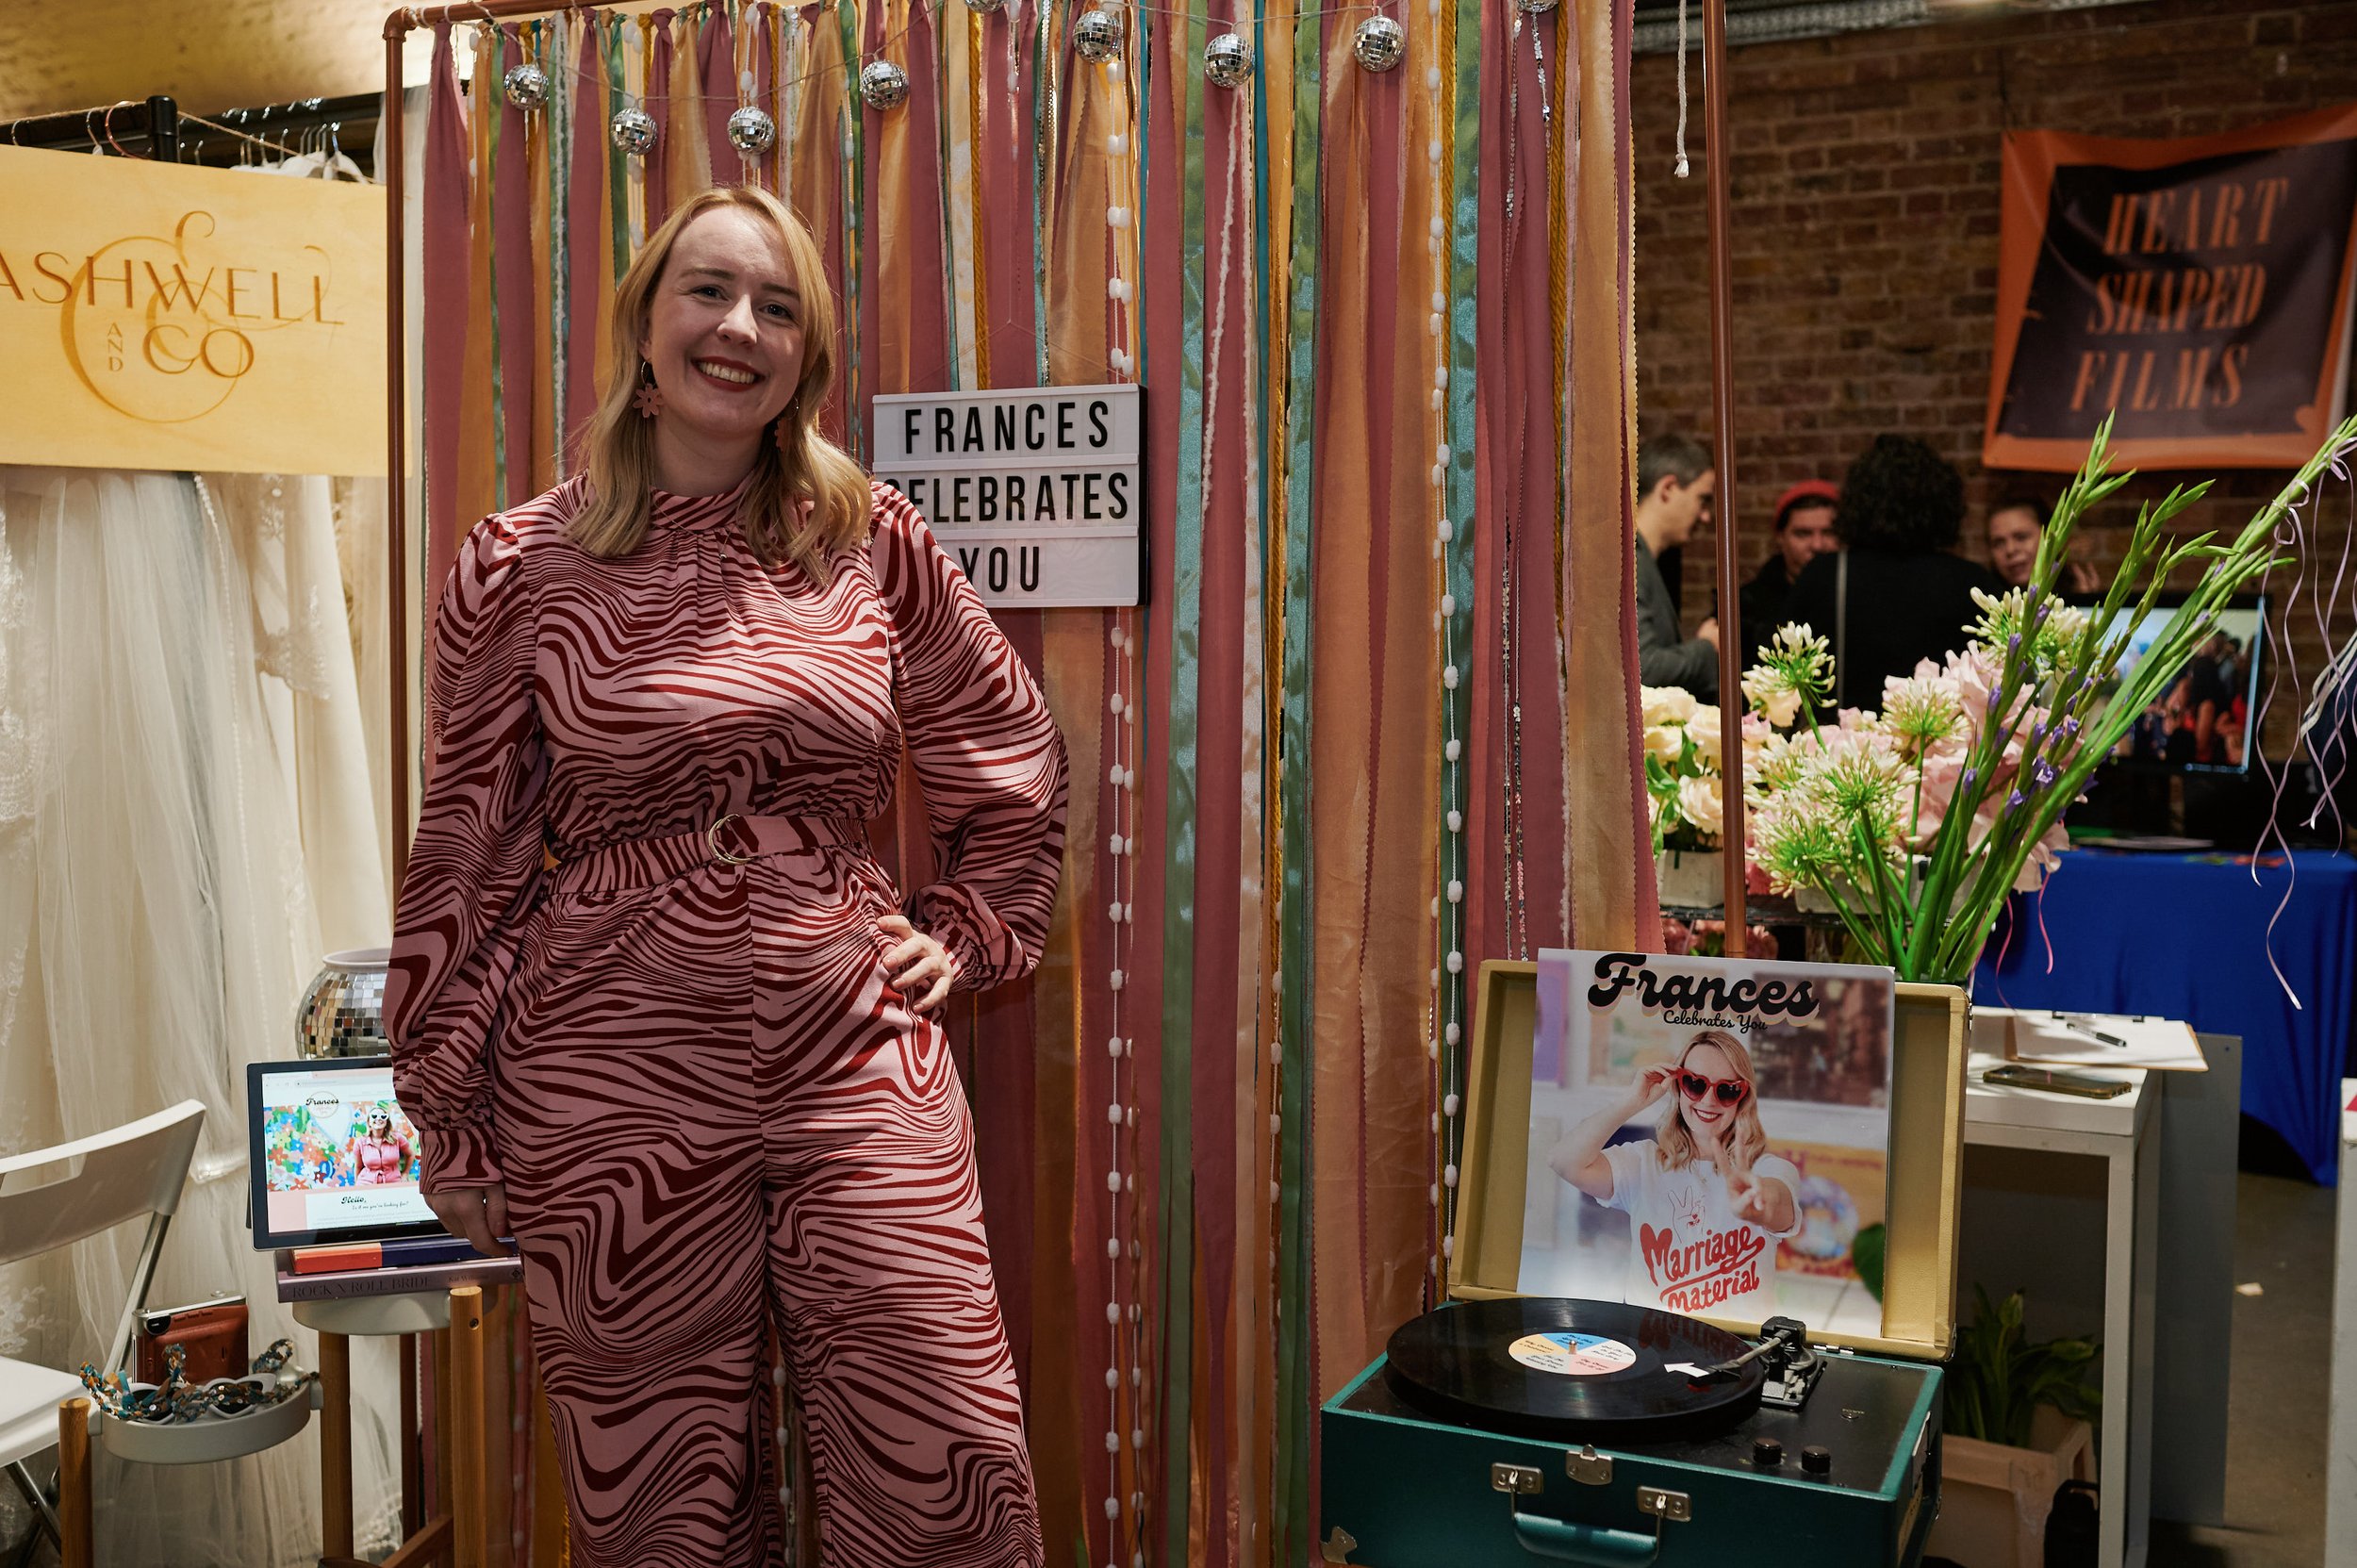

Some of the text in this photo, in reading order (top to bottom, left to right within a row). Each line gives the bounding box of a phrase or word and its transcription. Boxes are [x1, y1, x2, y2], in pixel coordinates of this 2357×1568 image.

[2102, 178, 2289, 255] HEART
[2086, 263, 2266, 334] SHAPED
[107, 322, 124, 371] AND
[142, 323, 255, 378] CO
[2070, 344, 2250, 411] FILMS
[905, 401, 1110, 454] FRANCES
[883, 471, 1129, 523] ELEBRATES
[959, 545, 1040, 593] YOU
[1588, 952, 1820, 1018] Frances
[1663, 1009, 1769, 1034] Celebrates You
[305, 1098, 339, 1107] Frances
[1640, 1222, 1766, 1287] Marriage
[292, 1284, 332, 1298] ROCK
[351, 1279, 387, 1293] ROLL
